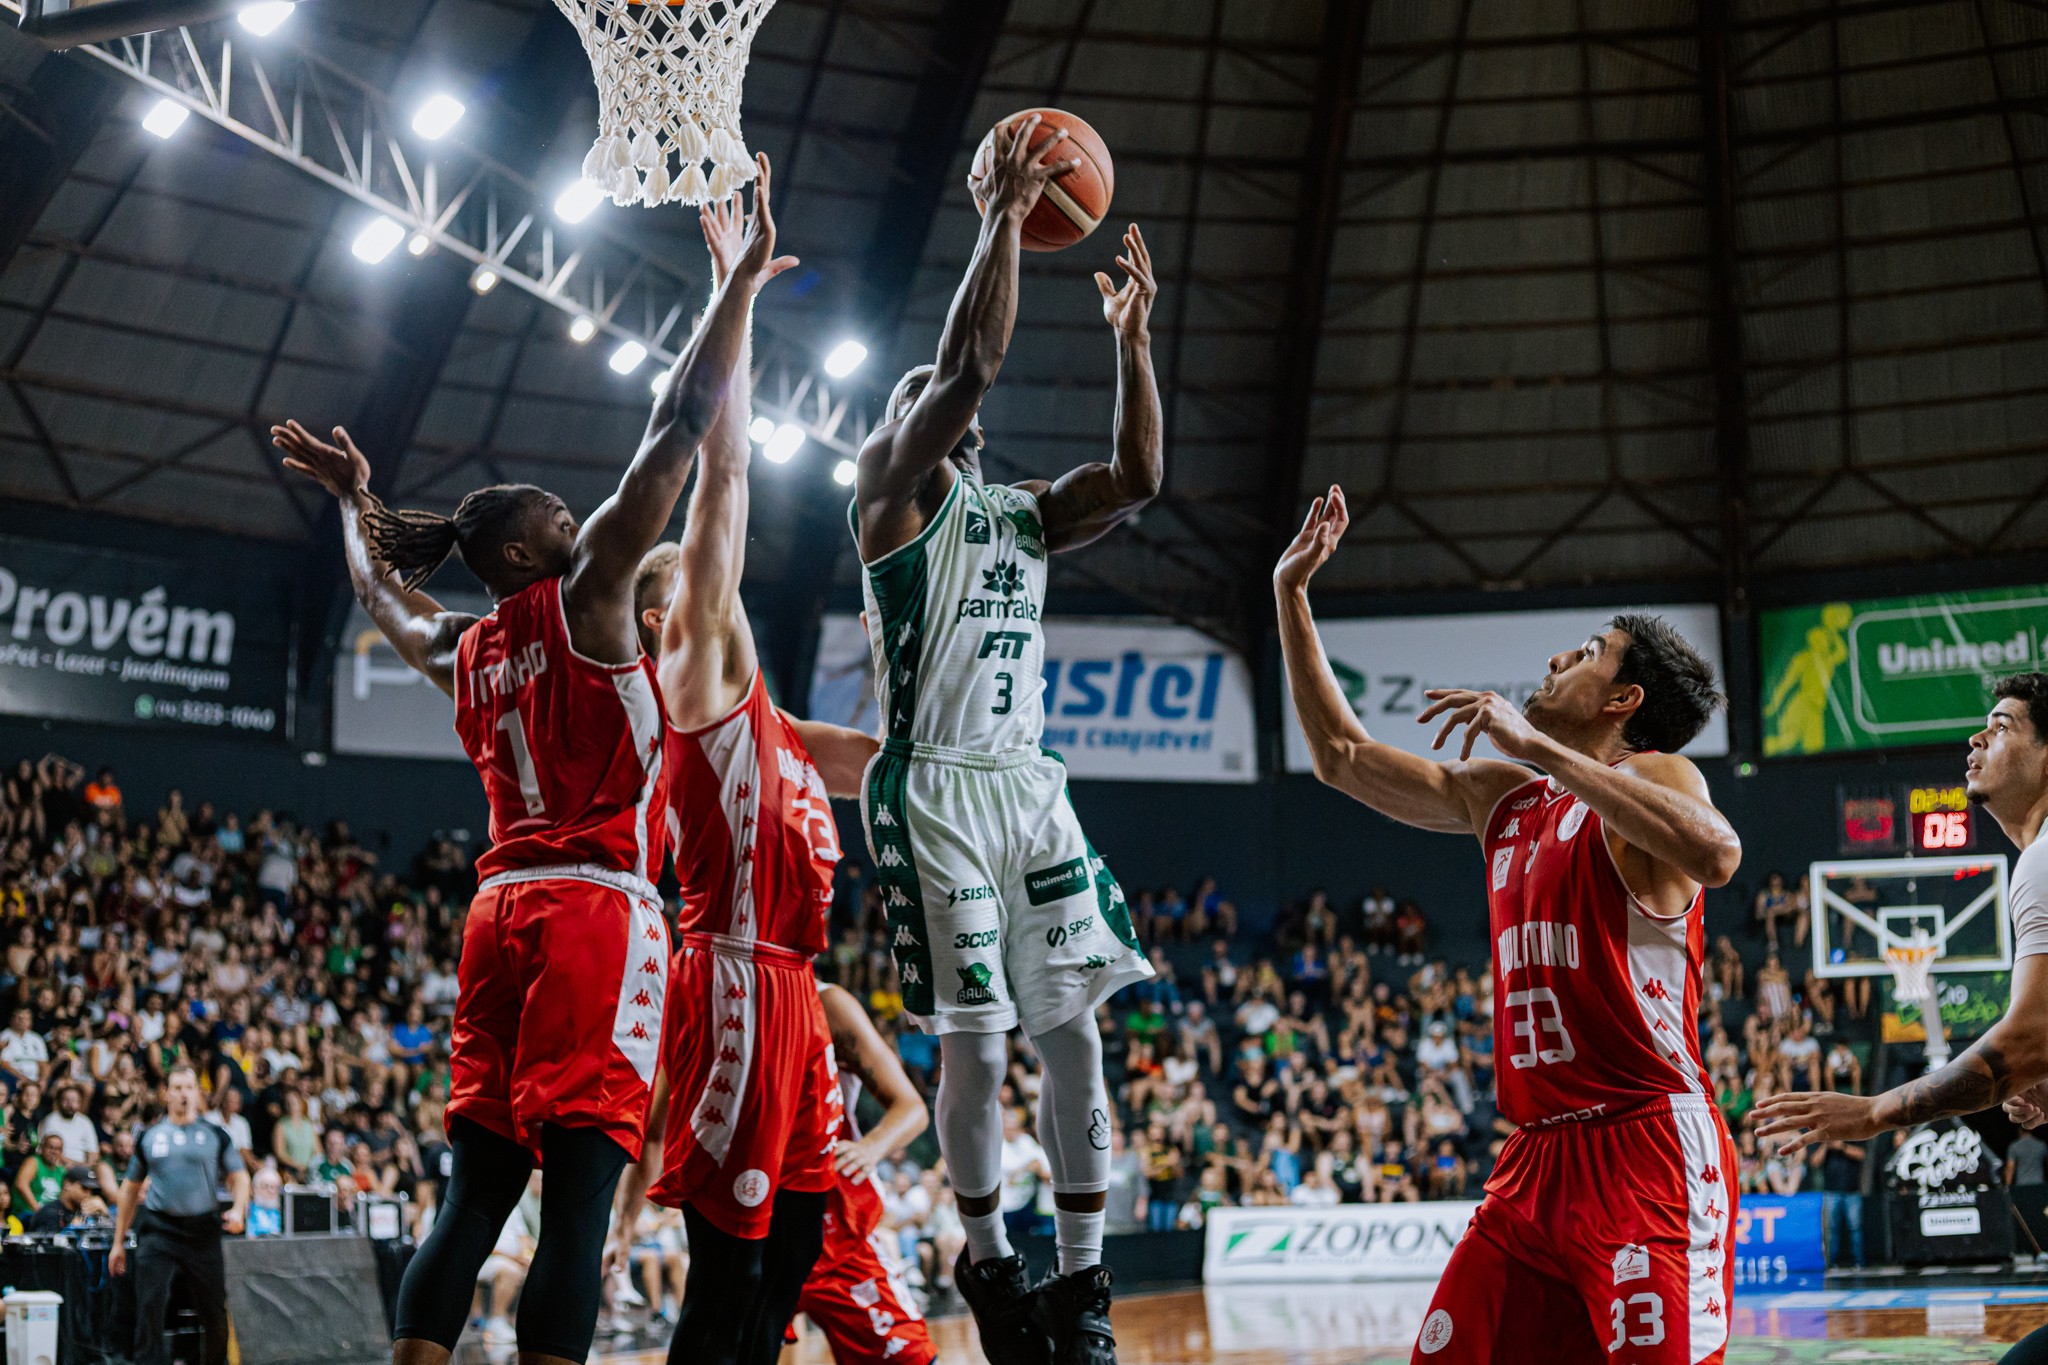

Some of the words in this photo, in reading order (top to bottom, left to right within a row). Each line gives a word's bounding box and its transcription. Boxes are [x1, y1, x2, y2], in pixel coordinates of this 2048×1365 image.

[956, 597, 1041, 624] parmala
[1877, 630, 2030, 675] Unimed
[991, 672, 1014, 715] 3
[496, 707, 546, 817] 1
[1923, 812, 1968, 848] 06
[1031, 868, 1073, 890] Unimed
[1505, 987, 1576, 1070] 33
[1607, 1292, 1665, 1354] 33
